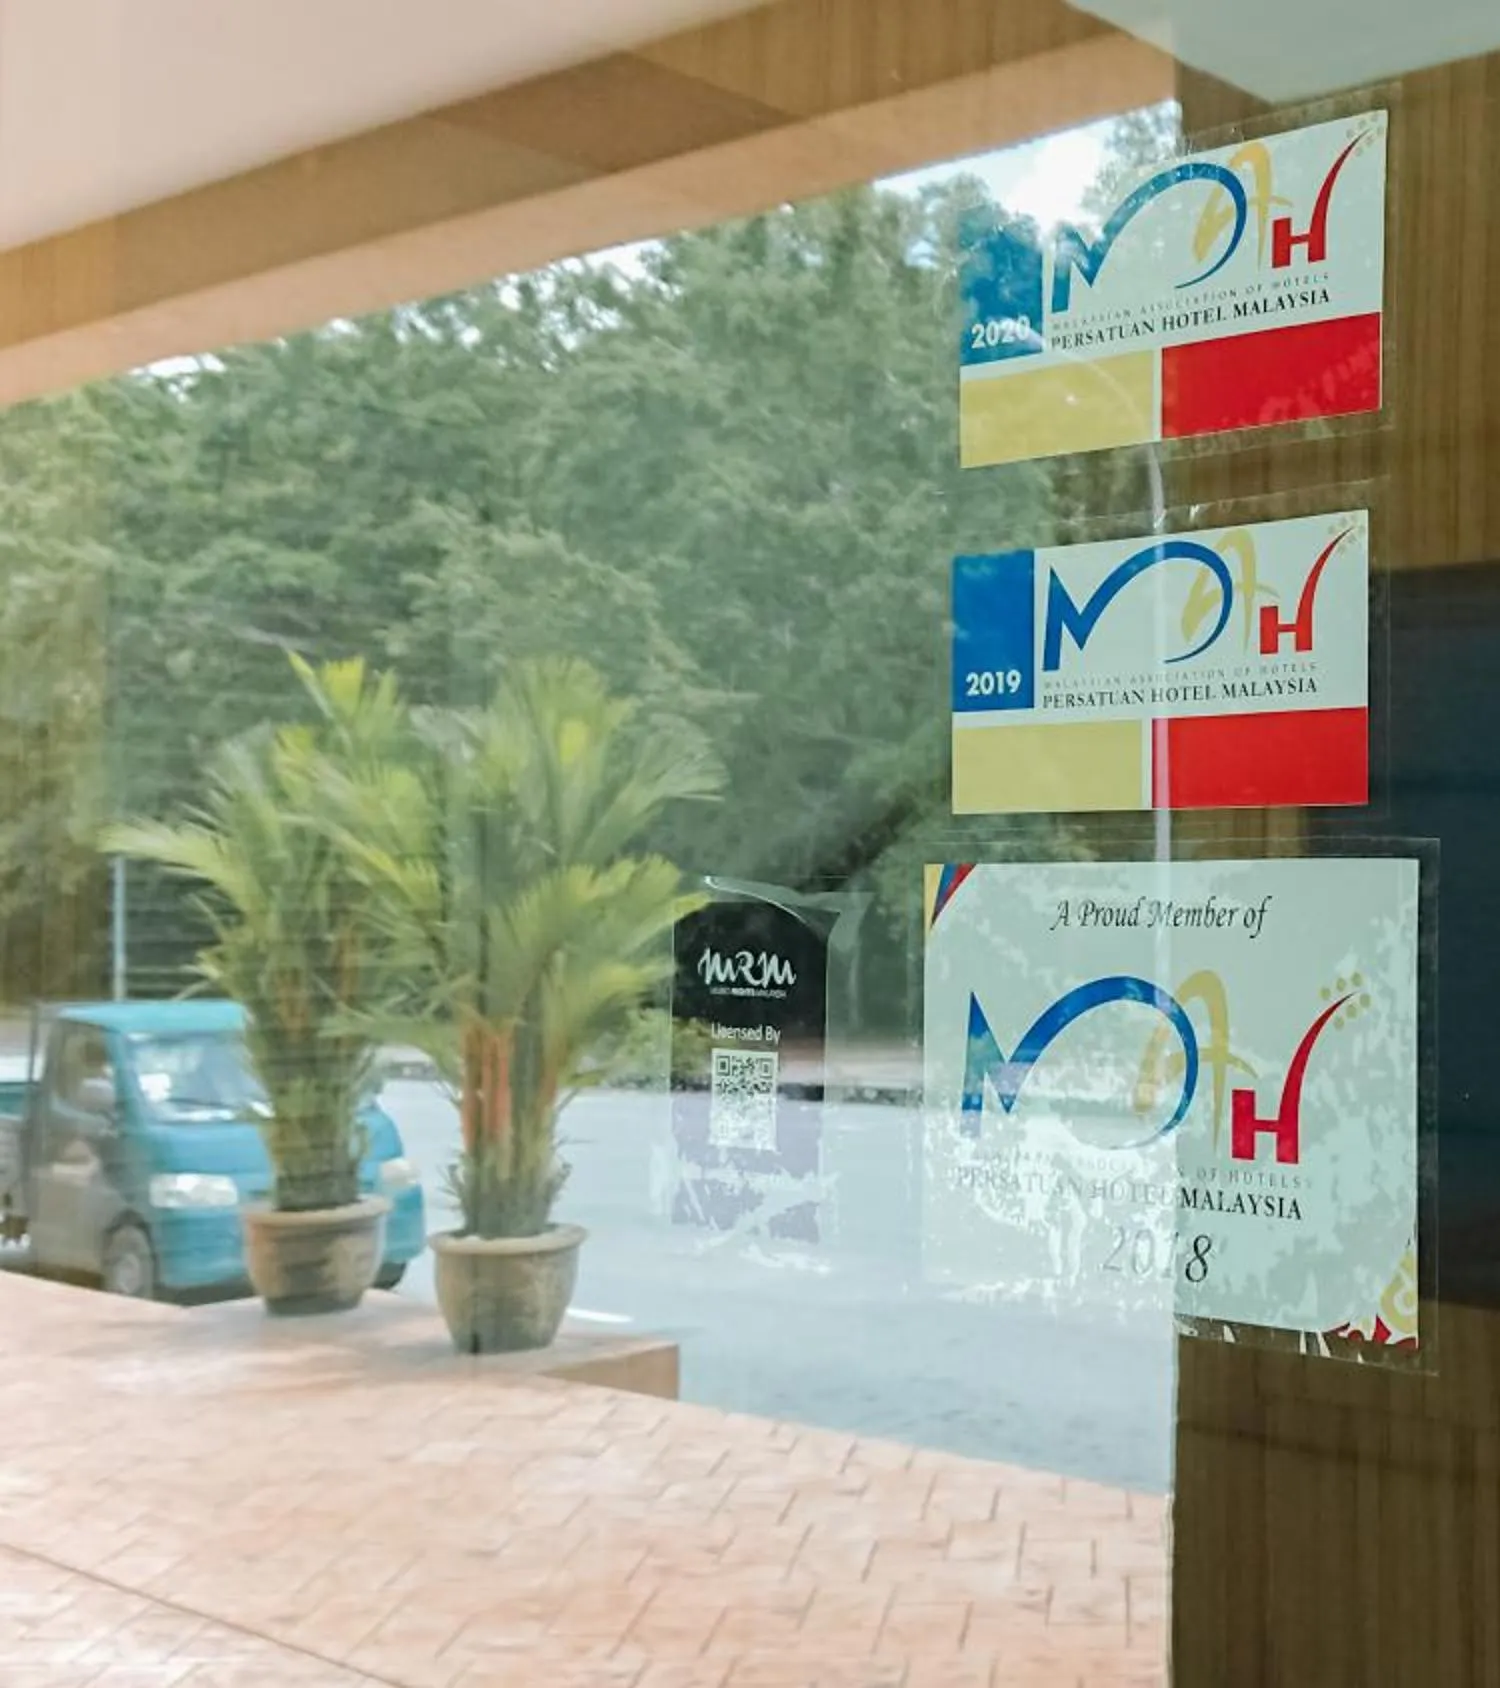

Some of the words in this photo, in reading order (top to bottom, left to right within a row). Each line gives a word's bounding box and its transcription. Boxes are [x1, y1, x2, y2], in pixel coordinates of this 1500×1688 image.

[971, 314, 1030, 349] 2020
[1050, 319, 1155, 350] PERSATUAN
[1161, 307, 1227, 332] HOTEL
[1233, 288, 1330, 318] MALAYSIA
[965, 669, 1022, 697] 2019
[1259, 661, 1318, 675] HOTELS
[1042, 690, 1145, 709] PERSATUAN
[1151, 685, 1217, 703] HOTEL
[1222, 677, 1318, 698] MALAYSIA
[1050, 899, 1071, 931] A
[1078, 895, 1146, 928] Proud
[1147, 895, 1240, 929] Member
[1243, 895, 1272, 939] of
[711, 1021, 763, 1041] Licensed
[765, 1025, 781, 1045] By
[1228, 1169, 1303, 1190] HOTELS
[1179, 1187, 1303, 1221] MALAYSIA
